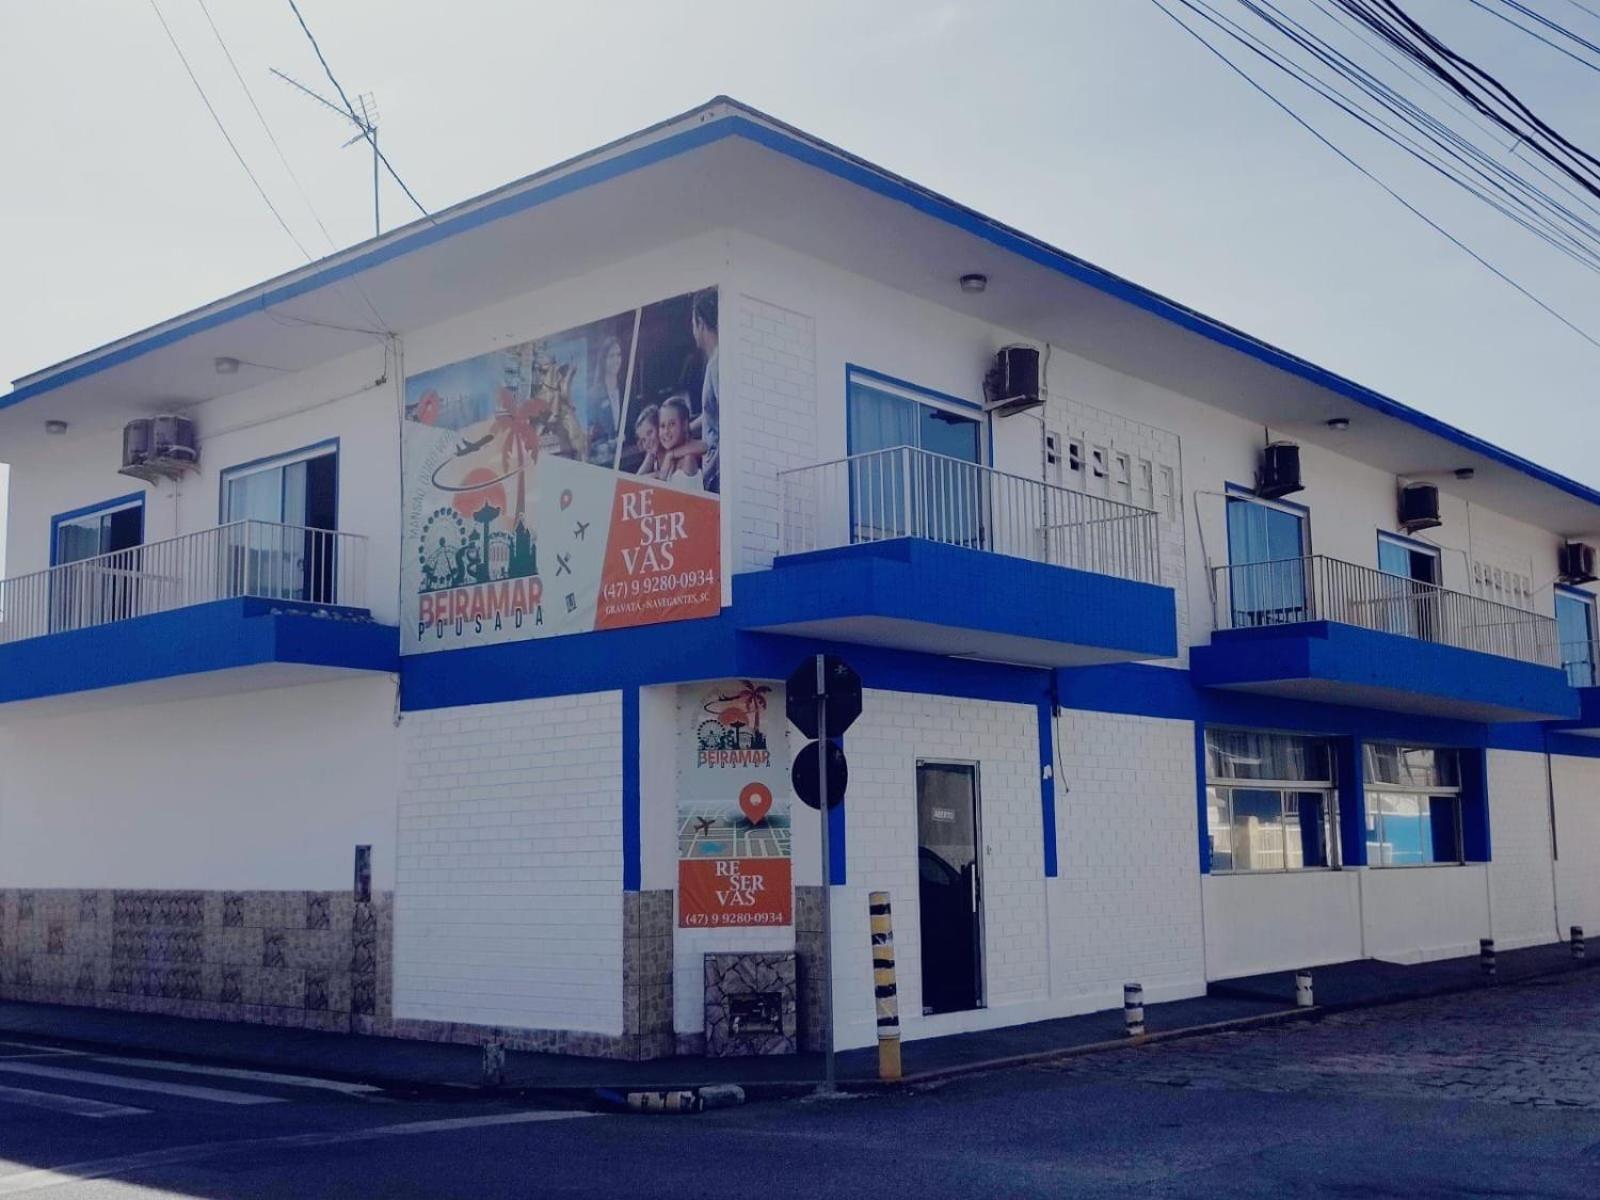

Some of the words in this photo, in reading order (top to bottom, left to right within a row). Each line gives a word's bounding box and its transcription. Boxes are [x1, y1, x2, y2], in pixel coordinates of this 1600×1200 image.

[621, 489, 654, 521] RE
[640, 511, 688, 546] SER
[621, 542, 675, 576] VAS
[604, 580, 628, 601] (47)
[631, 579, 640, 595] 9
[643, 569, 714, 594] 9280-0934
[418, 576, 543, 629] BEIRAMAR
[418, 605, 543, 641] POUSADA
[698, 750, 770, 765] BEIRAMAR
[715, 861, 740, 876] RE
[730, 875, 765, 891] SER
[715, 888, 756, 906] VAS
[686, 913, 708, 925] (47)
[712, 914, 718, 924] 9
[722, 912, 782, 924] 9280-0934
